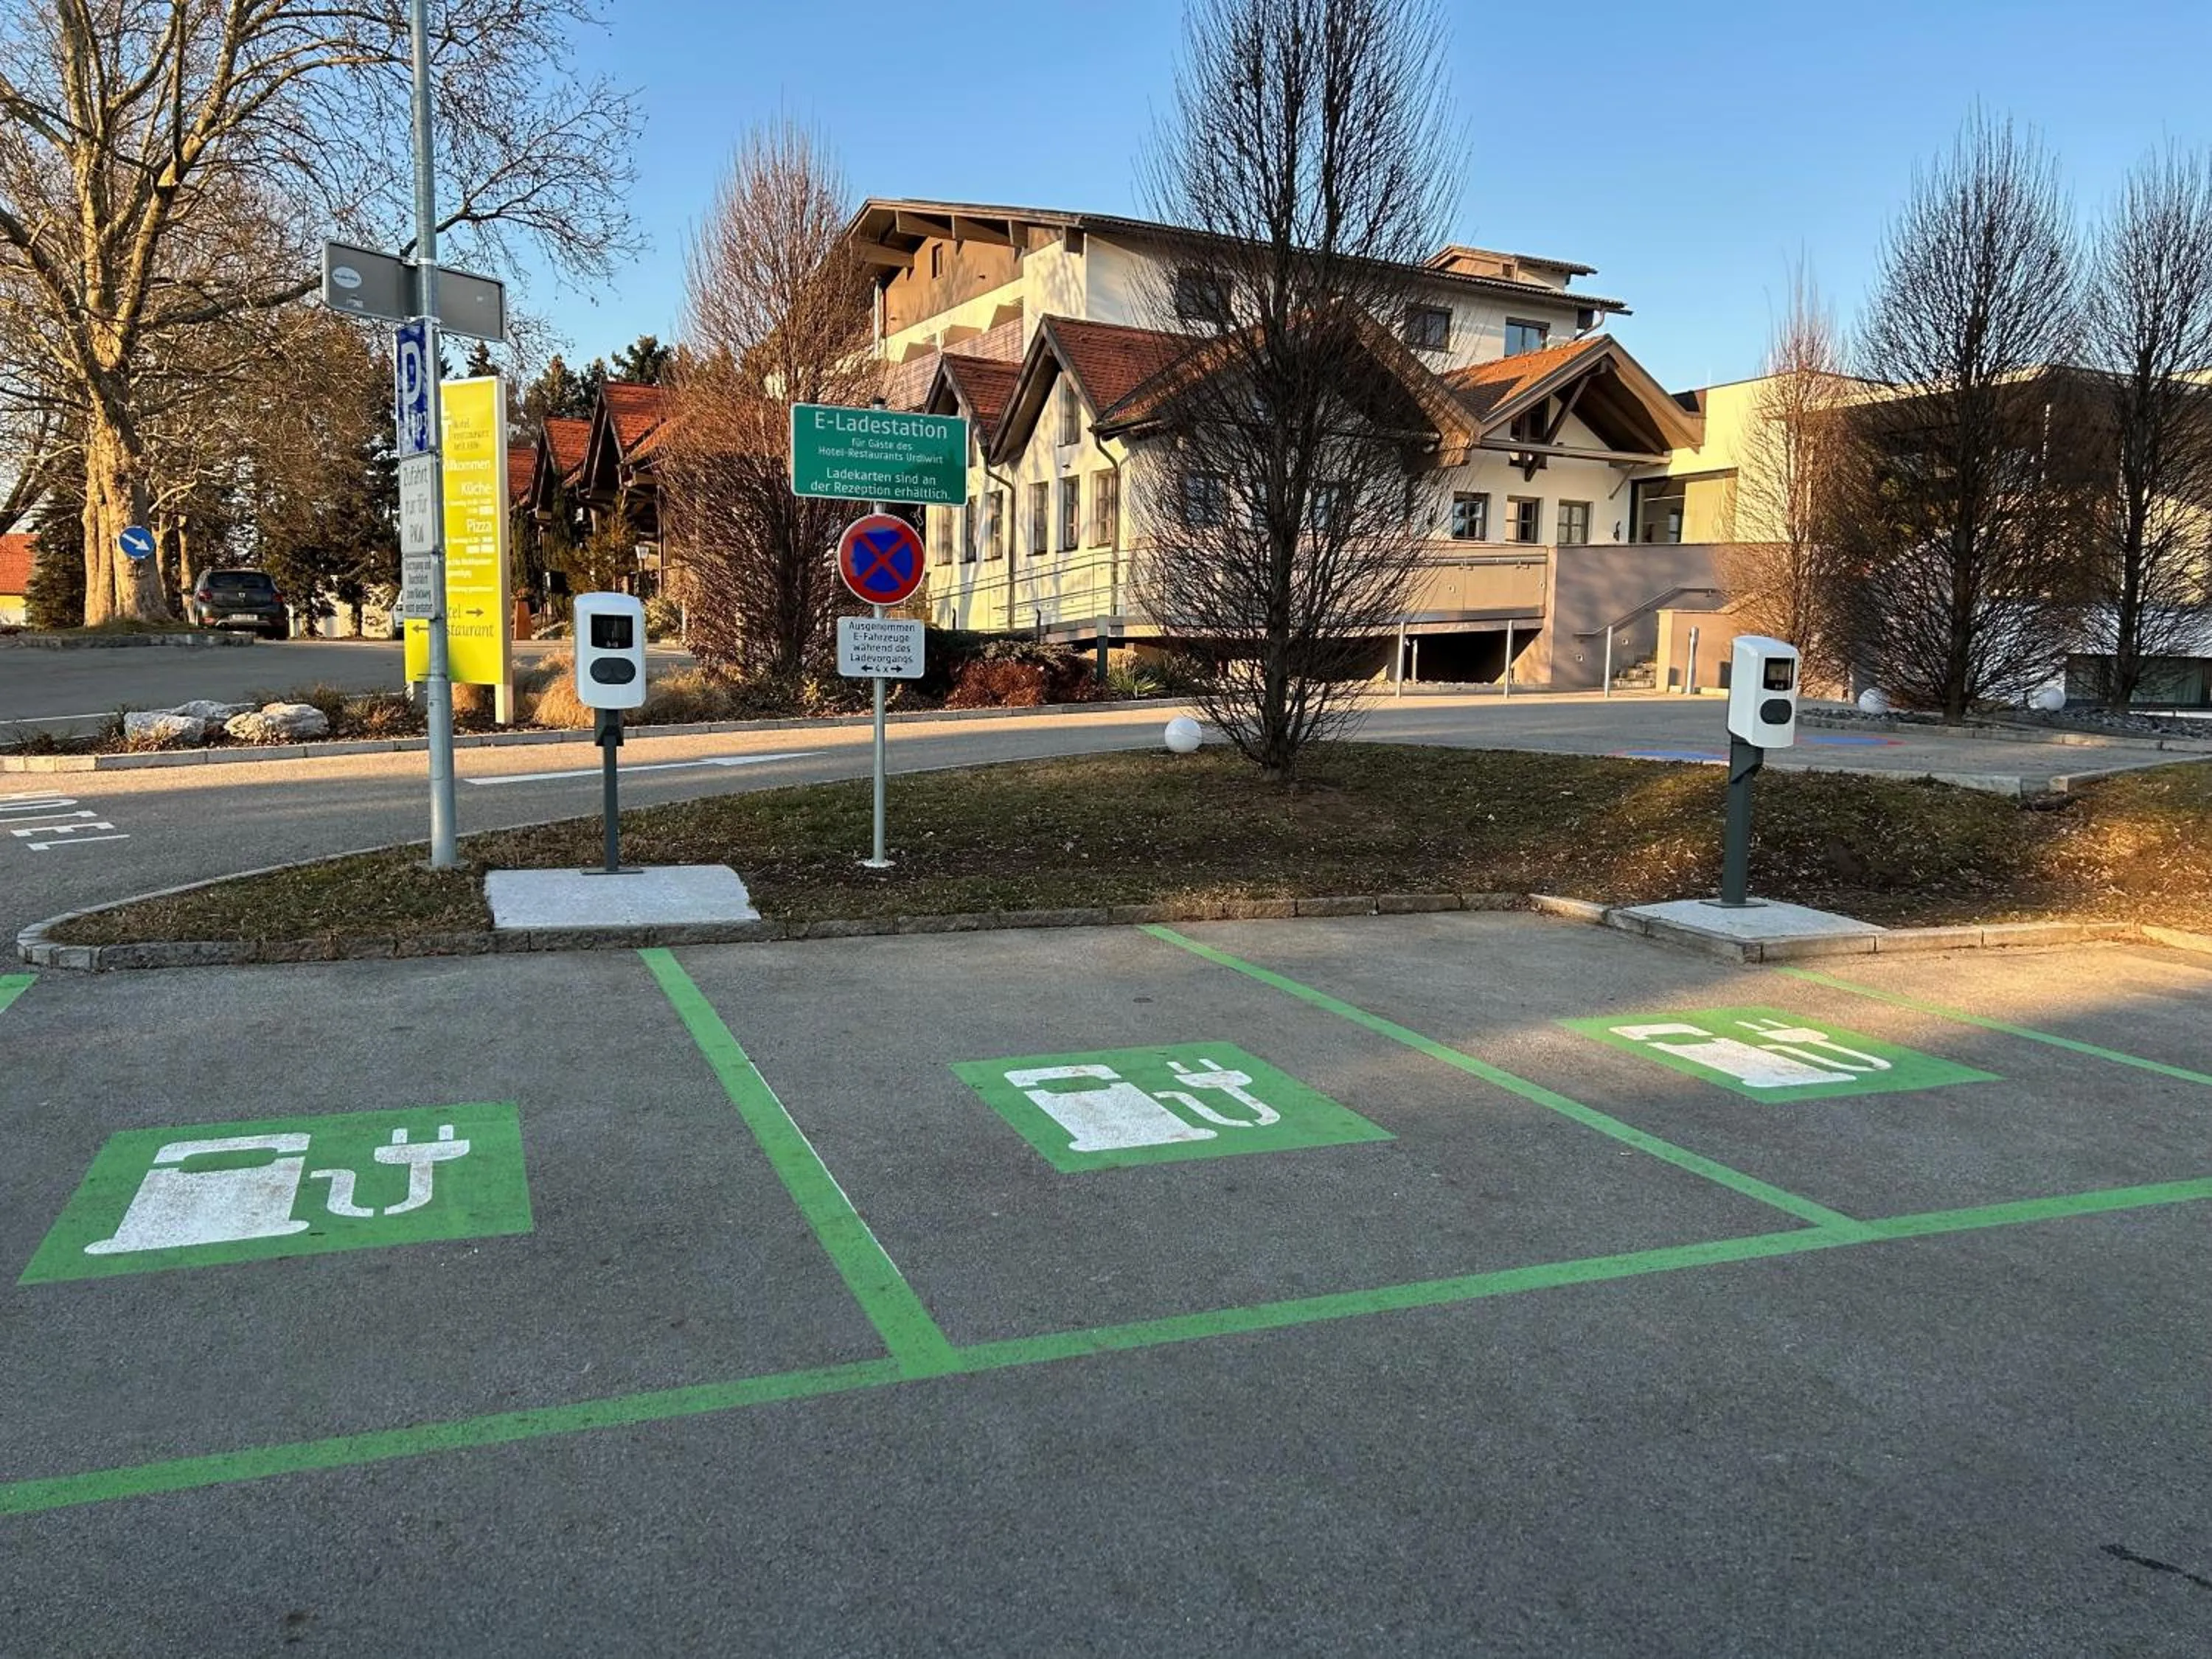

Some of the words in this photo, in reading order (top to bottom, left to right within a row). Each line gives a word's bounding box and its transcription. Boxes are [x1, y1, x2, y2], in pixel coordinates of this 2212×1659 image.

[815, 411, 947, 439] E-Ladestation
[852, 437, 866, 448] für
[868, 439, 894, 450] Gäste
[896, 441, 913, 451] des
[818, 445, 903, 462] Hotel-Restaurants
[826, 467, 891, 482] Ladekarten
[894, 471, 919, 484] sind
[922, 476, 936, 486] an
[810, 479, 831, 492] der
[834, 481, 891, 496] Rezeption
[894, 485, 951, 501] erhältlich.
[467, 518, 492, 534] Pizza
[447, 623, 494, 638] staurant
[849, 621, 915, 632] Ausgenommen
[853, 632, 911, 643] E-Fahrzeuge
[853, 643, 893, 653] während
[894, 644, 911, 653] des
[850, 653, 914, 664] Ladevorgangs
